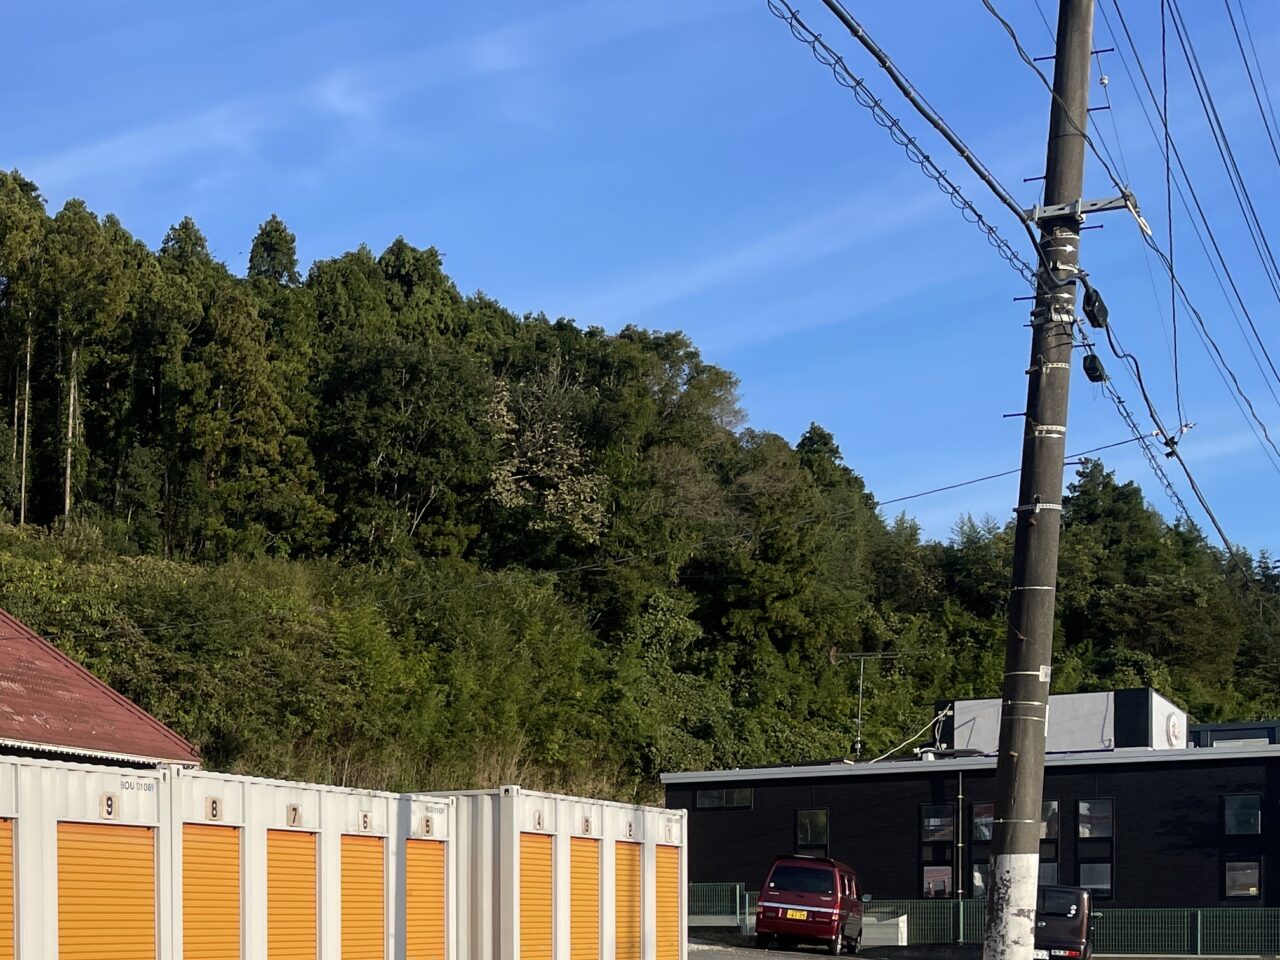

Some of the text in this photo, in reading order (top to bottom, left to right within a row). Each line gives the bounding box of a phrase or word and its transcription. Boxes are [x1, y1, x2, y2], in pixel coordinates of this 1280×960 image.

[106, 796, 113, 815] 9
[211, 800, 218, 818] 8
[292, 807, 298, 824] 7
